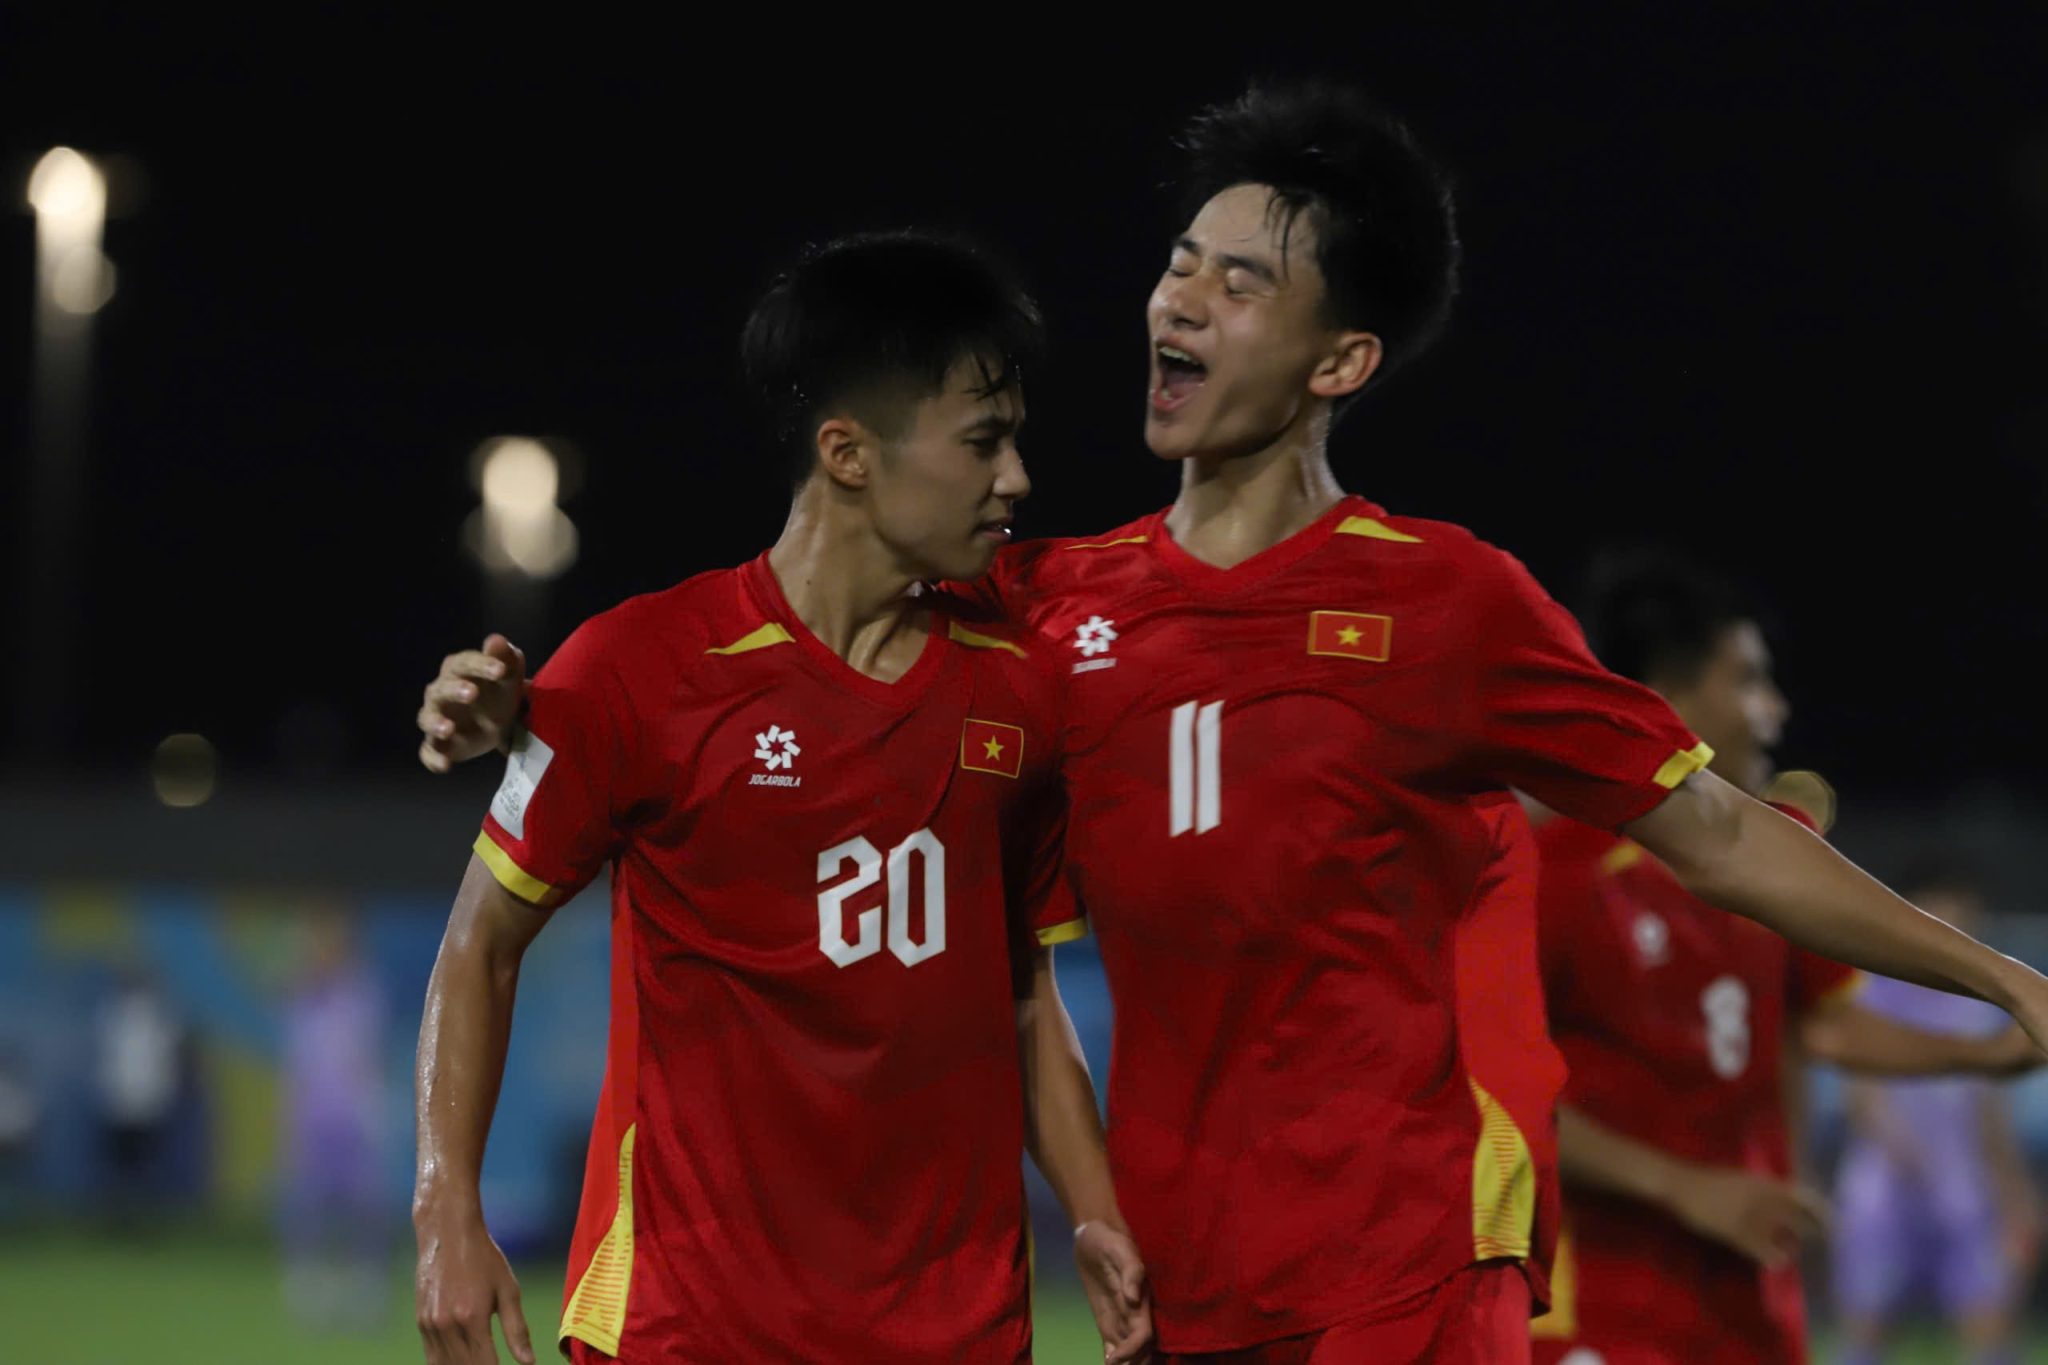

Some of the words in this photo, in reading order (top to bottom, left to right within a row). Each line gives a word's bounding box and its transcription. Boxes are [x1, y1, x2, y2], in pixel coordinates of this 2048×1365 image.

[748, 774, 801, 787] JOCARBOLA
[1169, 700, 1225, 837] 11
[817, 827, 946, 968] 20
